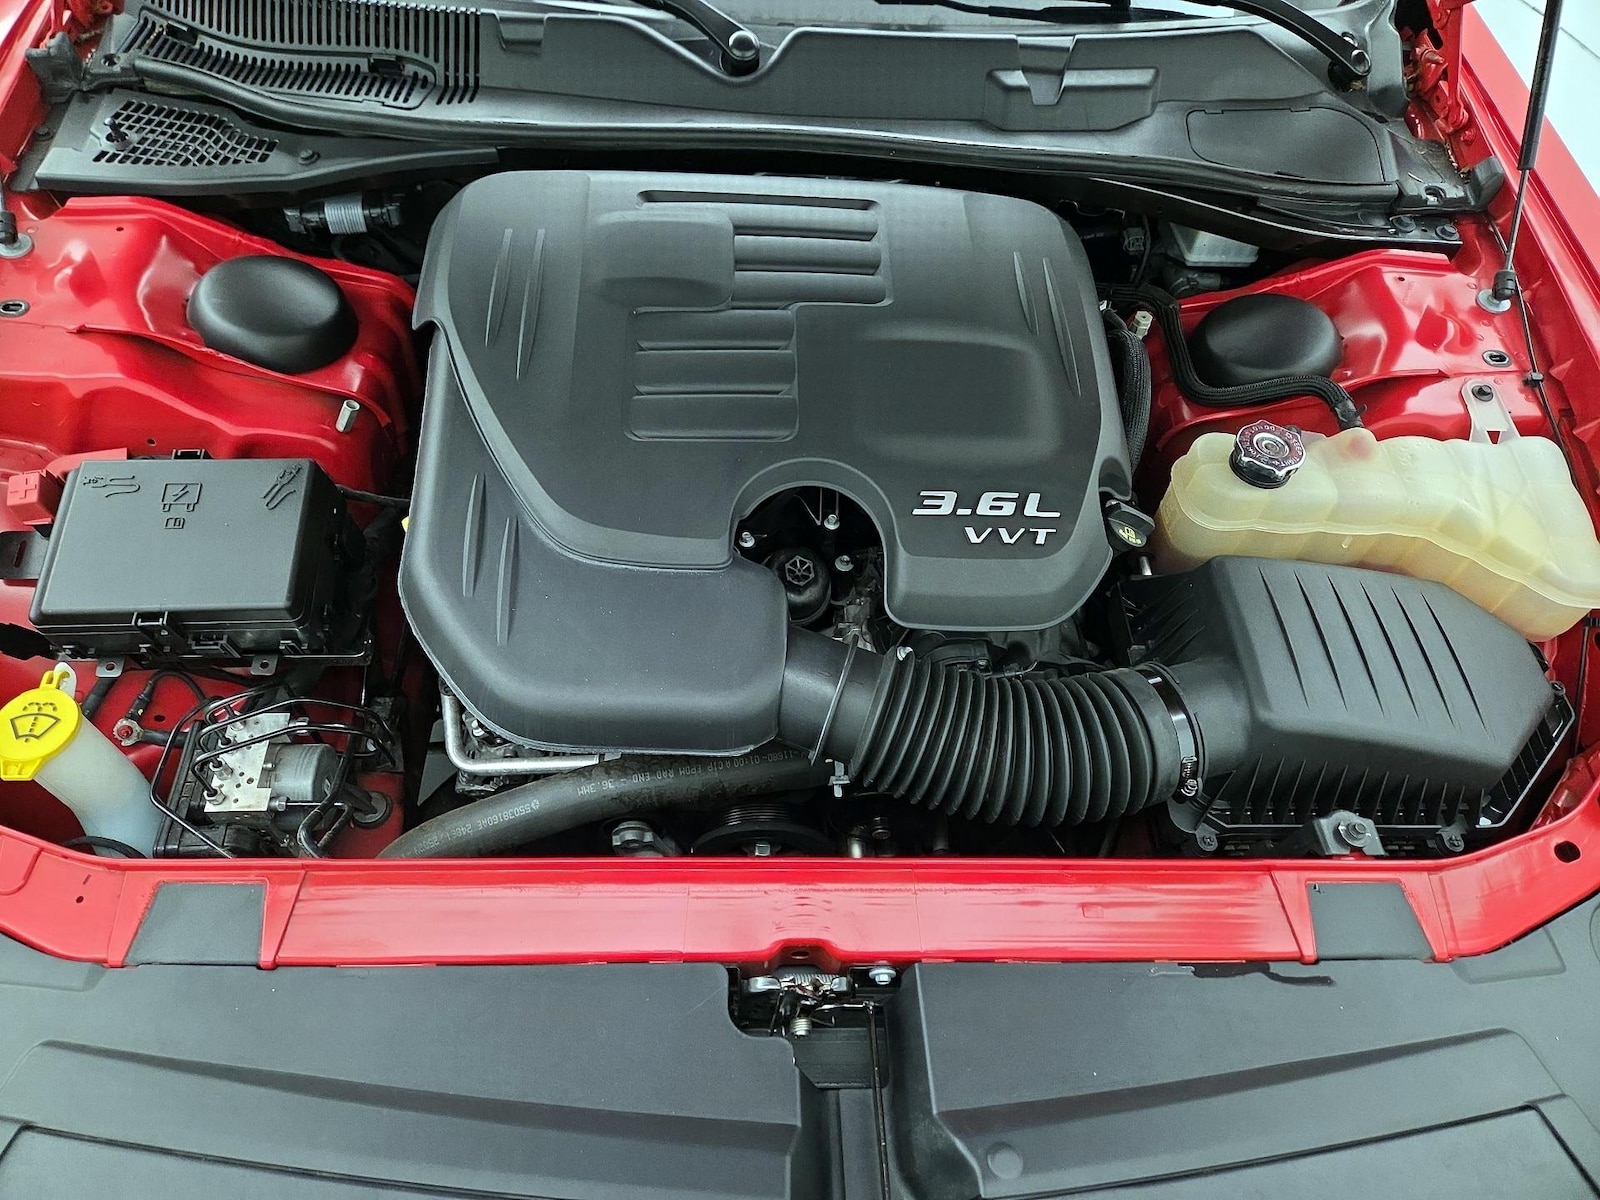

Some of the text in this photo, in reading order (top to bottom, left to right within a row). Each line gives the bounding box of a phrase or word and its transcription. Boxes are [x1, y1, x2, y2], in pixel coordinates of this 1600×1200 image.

[912, 489, 1061, 518] 3.6L
[964, 526, 1057, 545] VVT
[632, 771, 651, 784] END
[577, 778, 614, 797] 36.3MM
[477, 803, 531, 831] 55038160AE
